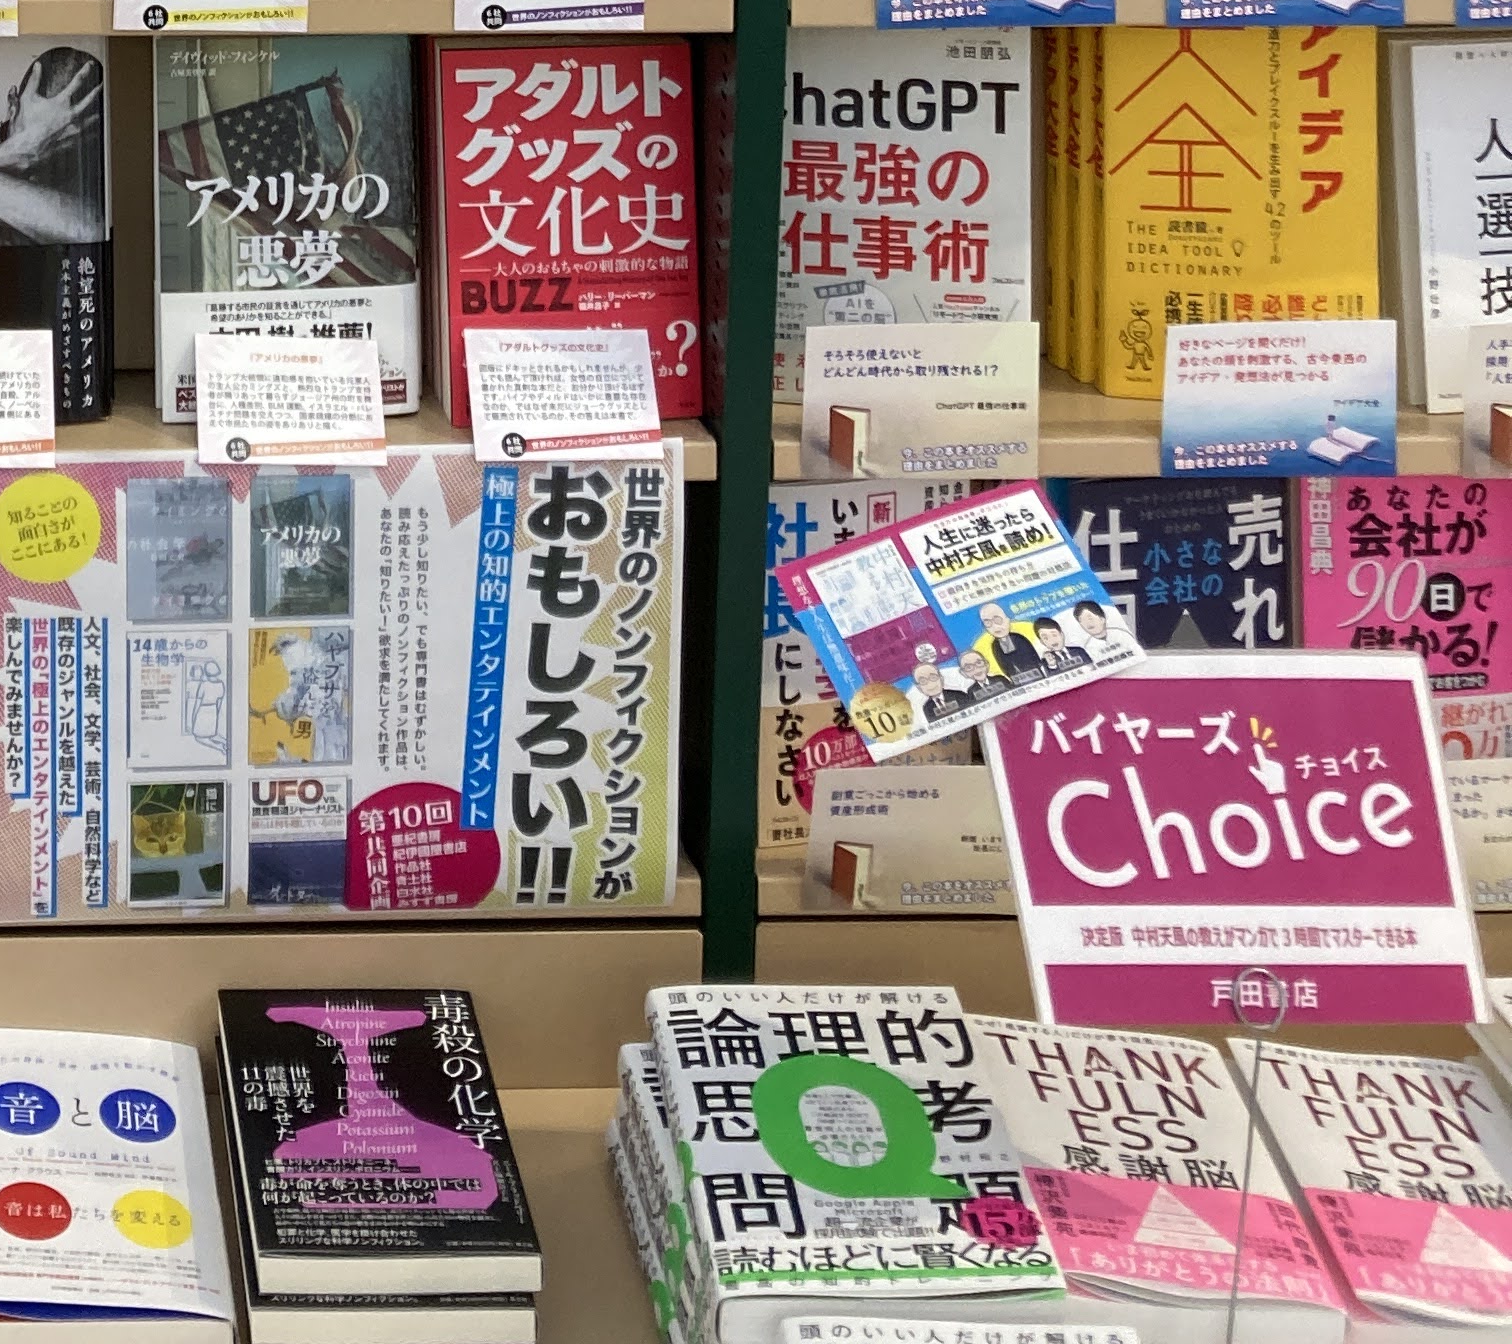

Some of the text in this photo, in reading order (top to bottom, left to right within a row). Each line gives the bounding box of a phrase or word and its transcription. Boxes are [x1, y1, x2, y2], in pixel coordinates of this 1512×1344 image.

[454, 58, 683, 125] アダルト
[779, 70, 1020, 134] hatGPT
[456, 121, 679, 187] グッズの
[782, 139, 990, 208] 最強の
[185, 171, 389, 226] アメリカの
[459, 184, 691, 260] 文化史
[235, 230, 343, 287] 悪夢
[782, 212, 990, 283] 仕事術
[1126, 261, 1245, 278] DICTIONARY
[1127, 241, 1225, 258] IDEA TOOL
[460, 277, 576, 314] BUZZ
[76, 256, 96, 409] 絶望死のアメリカ
[465, 472, 516, 826] 極上の知的エンタテインメント
[510, 464, 613, 905] おもしろい!!
[594, 467, 665, 901] 世界のノンフィクションが
[1029, 710, 1242, 758] バイヤーズ
[1294, 747, 1387, 778] チョイス
[1045, 768, 1415, 889] Choice
[319, 1015, 387, 1032] Atropine
[324, 999, 375, 1014] Insulin
[668, 990, 950, 1007] 頭のいい人だけが解ける
[316, 1032, 397, 1048] Strychnine
[332, 1049, 390, 1066] Aconite
[666, 1008, 976, 1072] 論理的
[982, 1030, 1225, 1089] THANK
[336, 1120, 417, 1138] Potassium
[342, 1138, 418, 1156] Polonium
